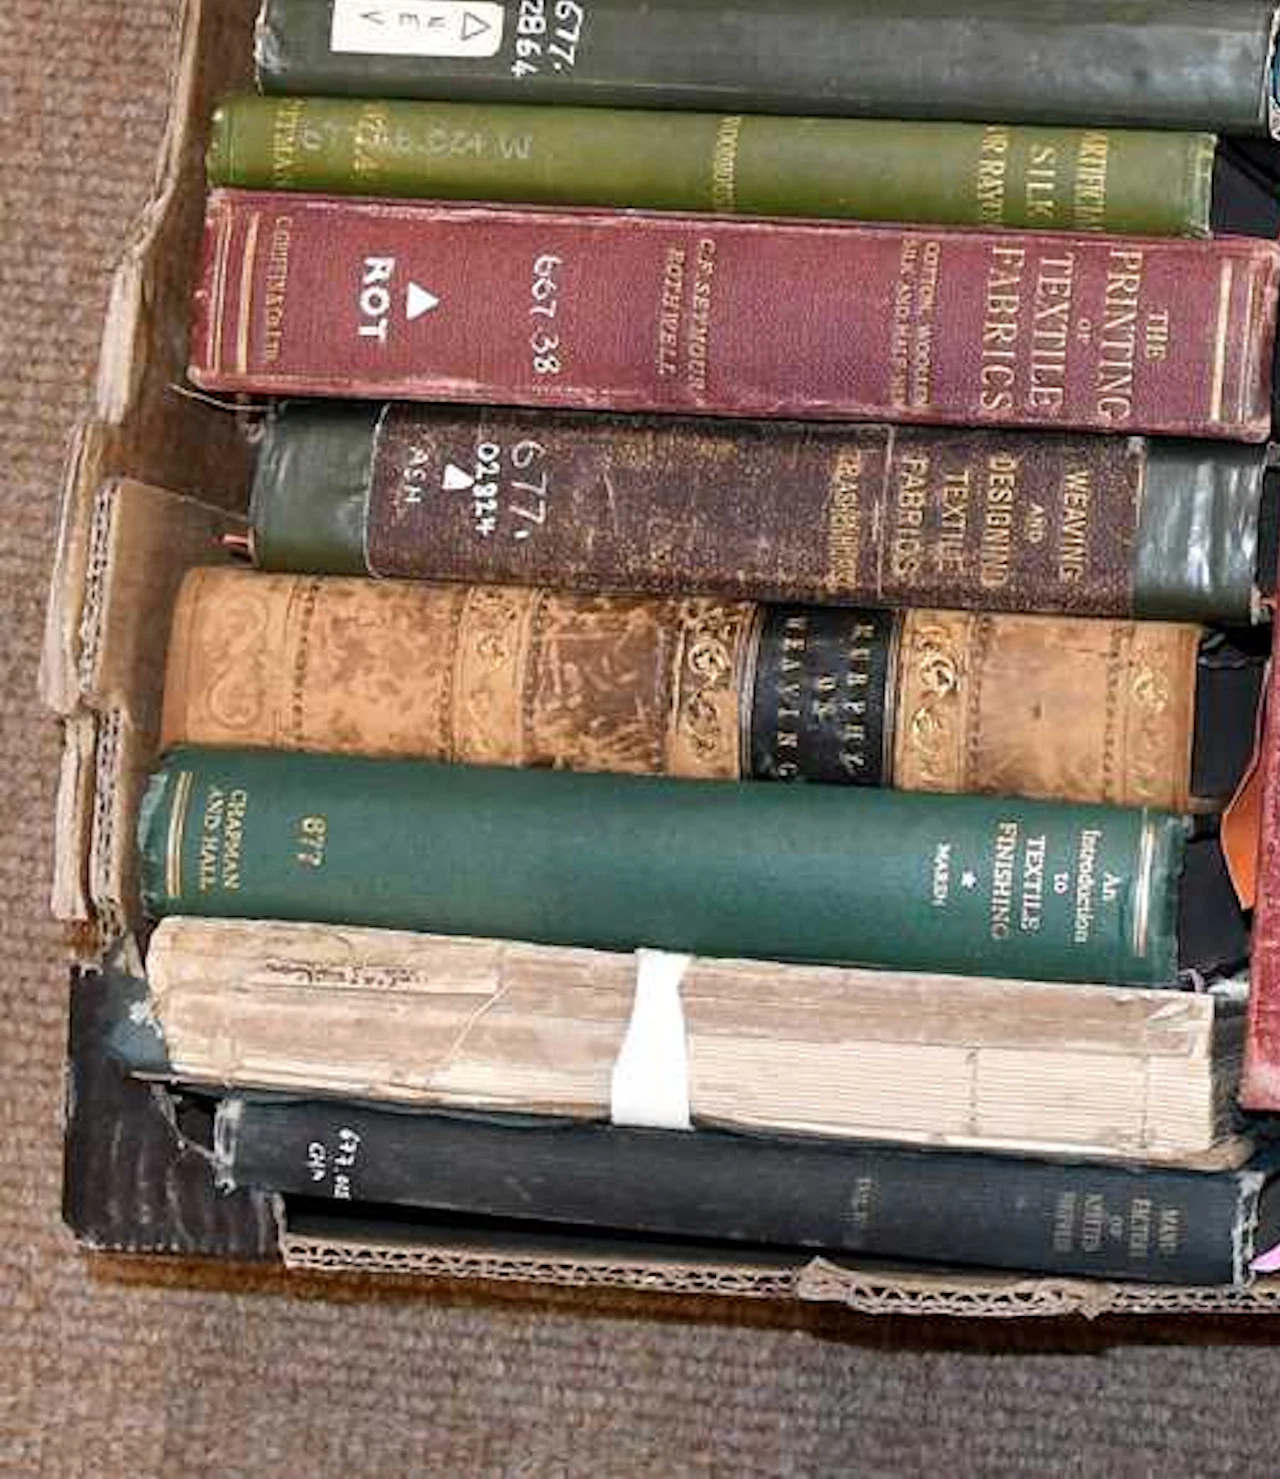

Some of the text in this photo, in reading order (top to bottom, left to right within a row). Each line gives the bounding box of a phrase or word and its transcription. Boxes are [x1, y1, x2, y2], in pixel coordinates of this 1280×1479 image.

[1024, 144, 1057, 218] SILK
[357, 255, 395, 343] ROT
[980, 246, 1026, 411] FABRICS
[1030, 251, 1076, 408] TEXTILE
[1077, 319, 1092, 344] OF
[1096, 249, 1144, 419] PRINTING
[1145, 308, 1170, 361] THE
[401, 445, 429, 504] ASH
[891, 455, 929, 578] FABRICS
[938, 470, 969, 573] TEXTILE
[1027, 501, 1046, 545] AND
[1061, 470, 1090, 582] WEAVING
[198, 787, 225, 891] AND HALL
[220, 787, 249, 890] CHAPMAN
[929, 842, 952, 907] MARSH
[989, 819, 1017, 941] FINISHING
[1018, 834, 1047, 932] TEXTILE
[1051, 871, 1070, 895] to
[1072, 829, 1102, 944] Introduction
[1100, 871, 1121, 903] An
